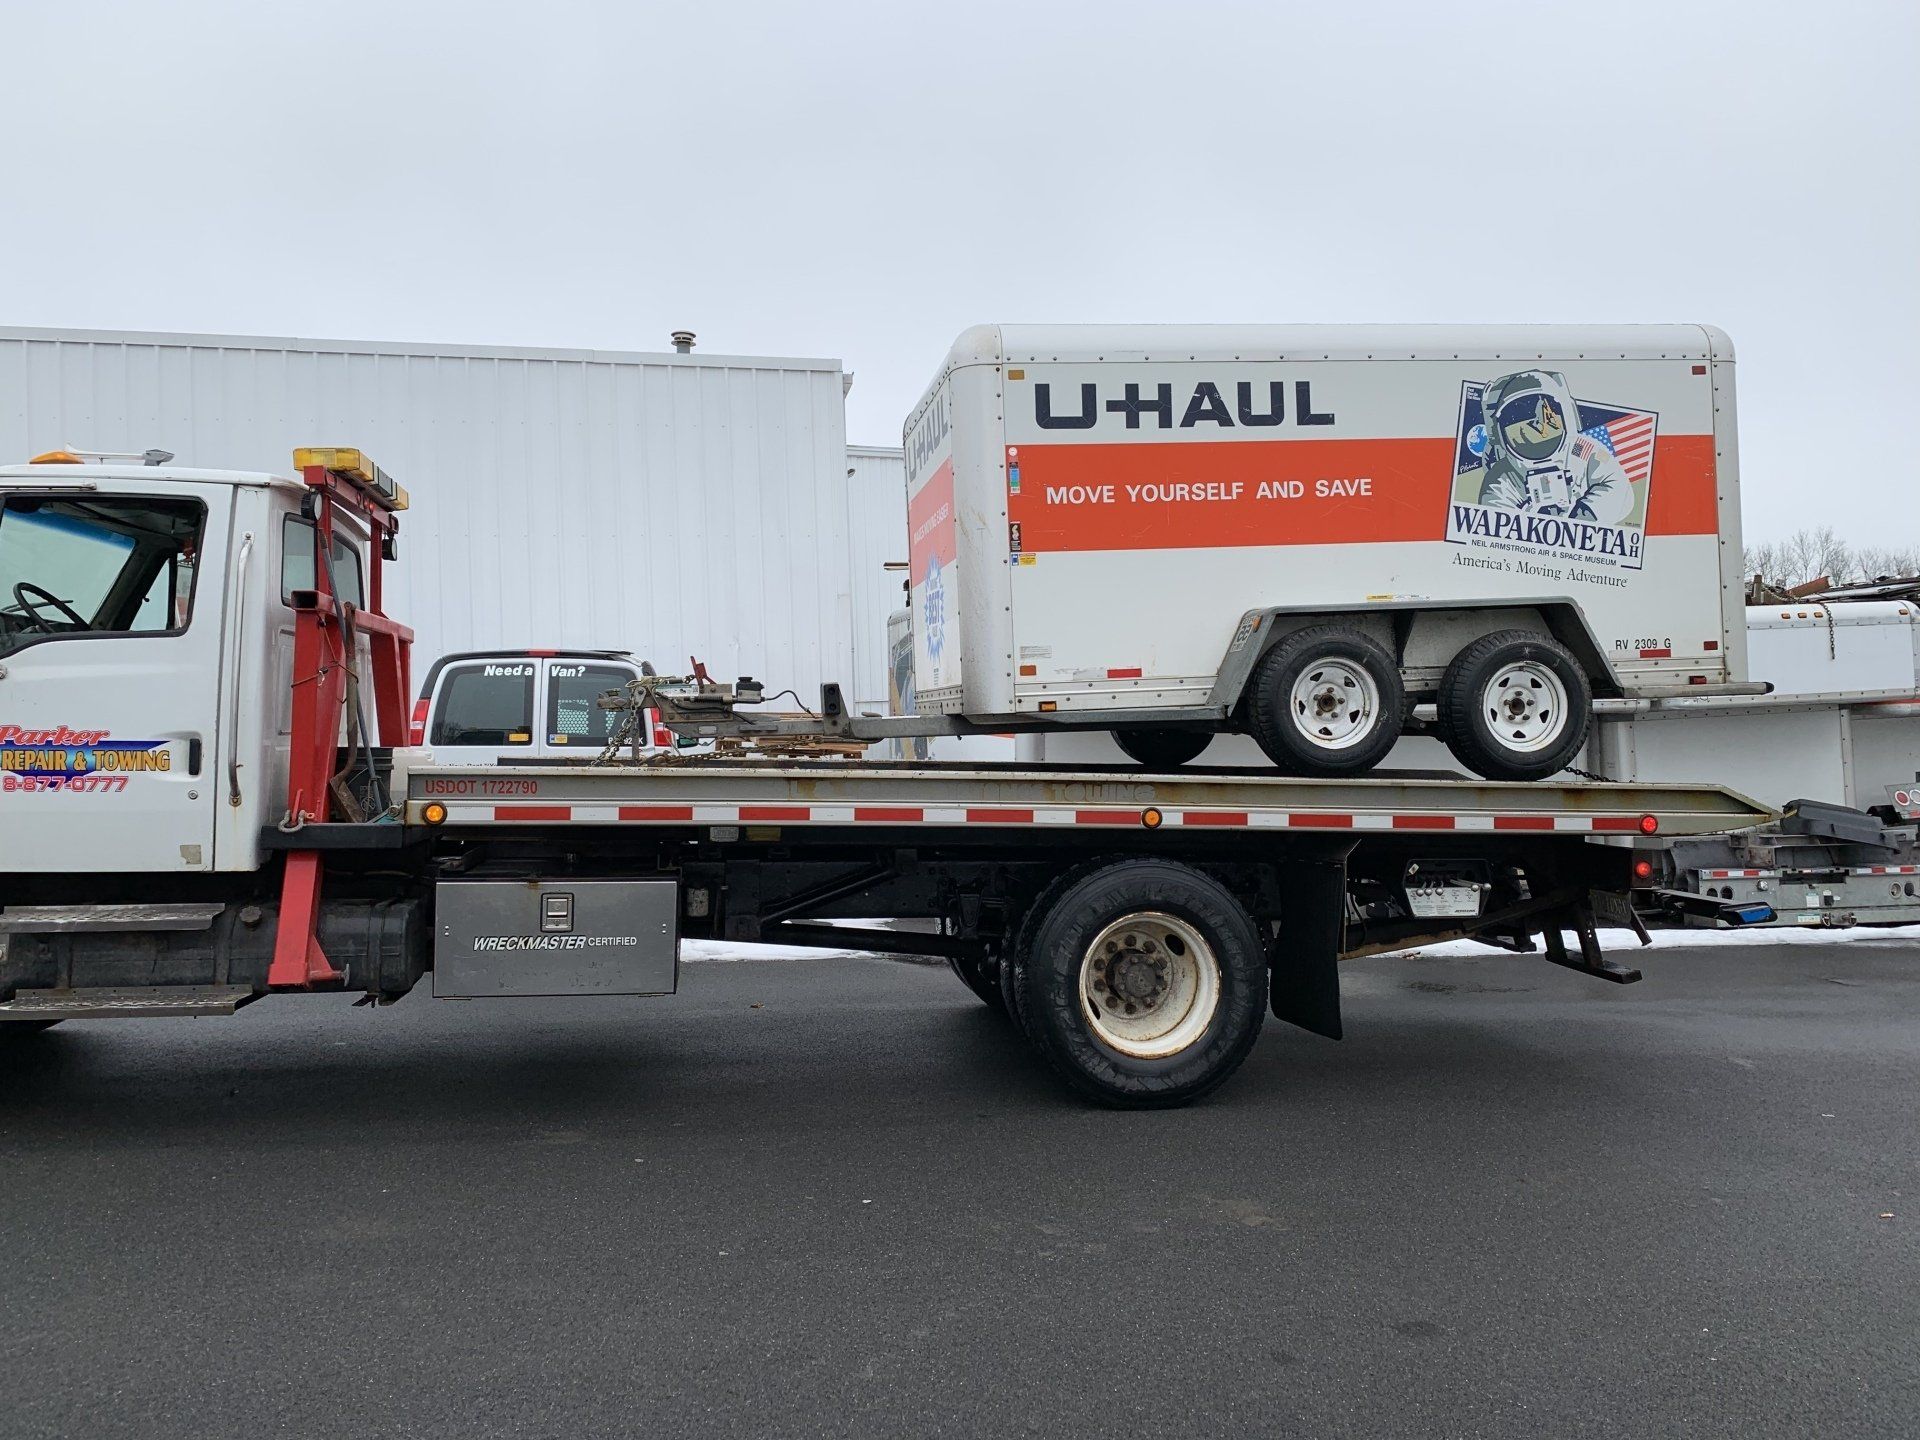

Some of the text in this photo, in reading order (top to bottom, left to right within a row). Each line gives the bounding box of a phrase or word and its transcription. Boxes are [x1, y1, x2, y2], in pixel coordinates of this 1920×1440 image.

[1034, 381, 1335, 429] U-HAUL
[1046, 478, 1373, 505] MOVE YOURSELF AND SAVE
[1453, 505, 1628, 557] WAPAKONETA
[1471, 539, 1617, 567] NEIL ARMSTRONG AIR & SPACE MUSEUM
[1452, 552, 1628, 588] America's Moving Adventure
[1615, 637, 1672, 650] RV 2309 G
[484, 664, 586, 677] Need a Van?
[0, 725, 111, 746] Parker
[0, 750, 171, 771] REPAIR & TOWING
[2, 775, 129, 793] 8-877-0777
[425, 780, 538, 794] USDOT 1722790
[473, 936, 638, 951] WRECKMASTER CERTIFIED
